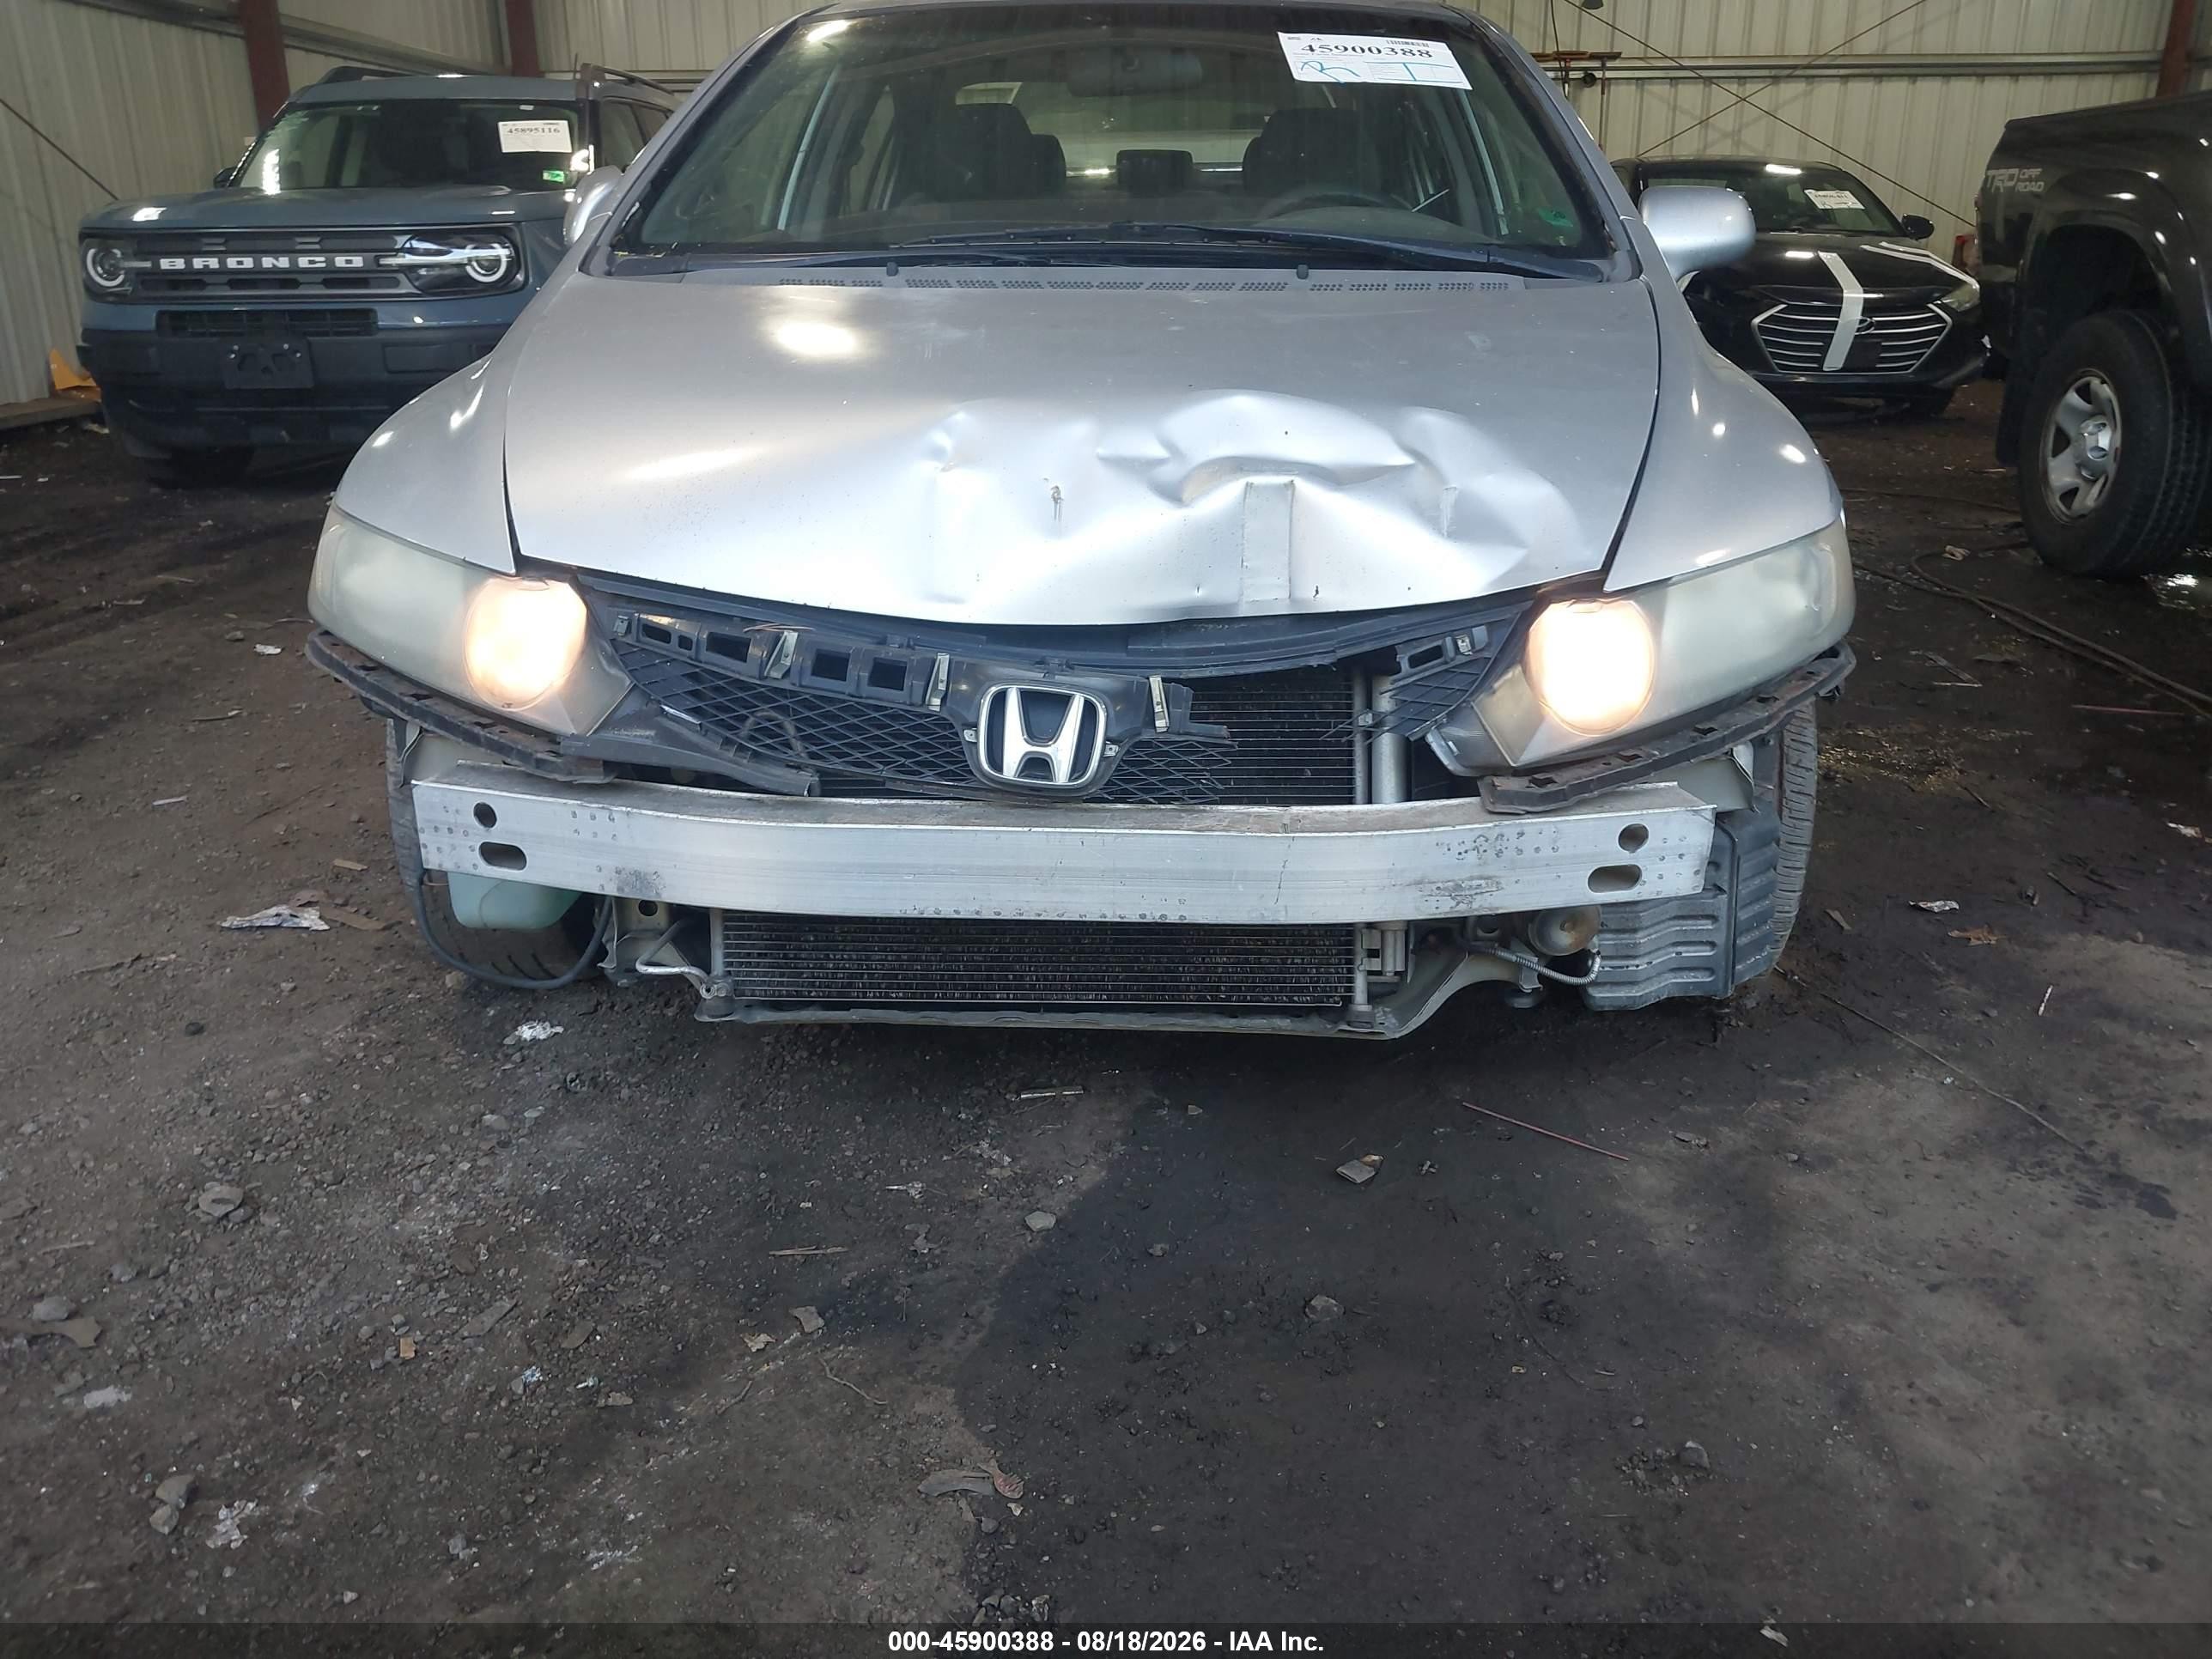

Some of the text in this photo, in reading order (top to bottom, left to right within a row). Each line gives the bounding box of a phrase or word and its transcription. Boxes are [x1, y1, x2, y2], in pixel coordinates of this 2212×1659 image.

[1301, 43, 1433, 58] 45900388
[1986, 168, 2020, 192] TRD
[2019, 168, 2042, 179] OFF
[2014, 181, 2045, 192] ROAD
[159, 256, 364, 270] BRONCO
